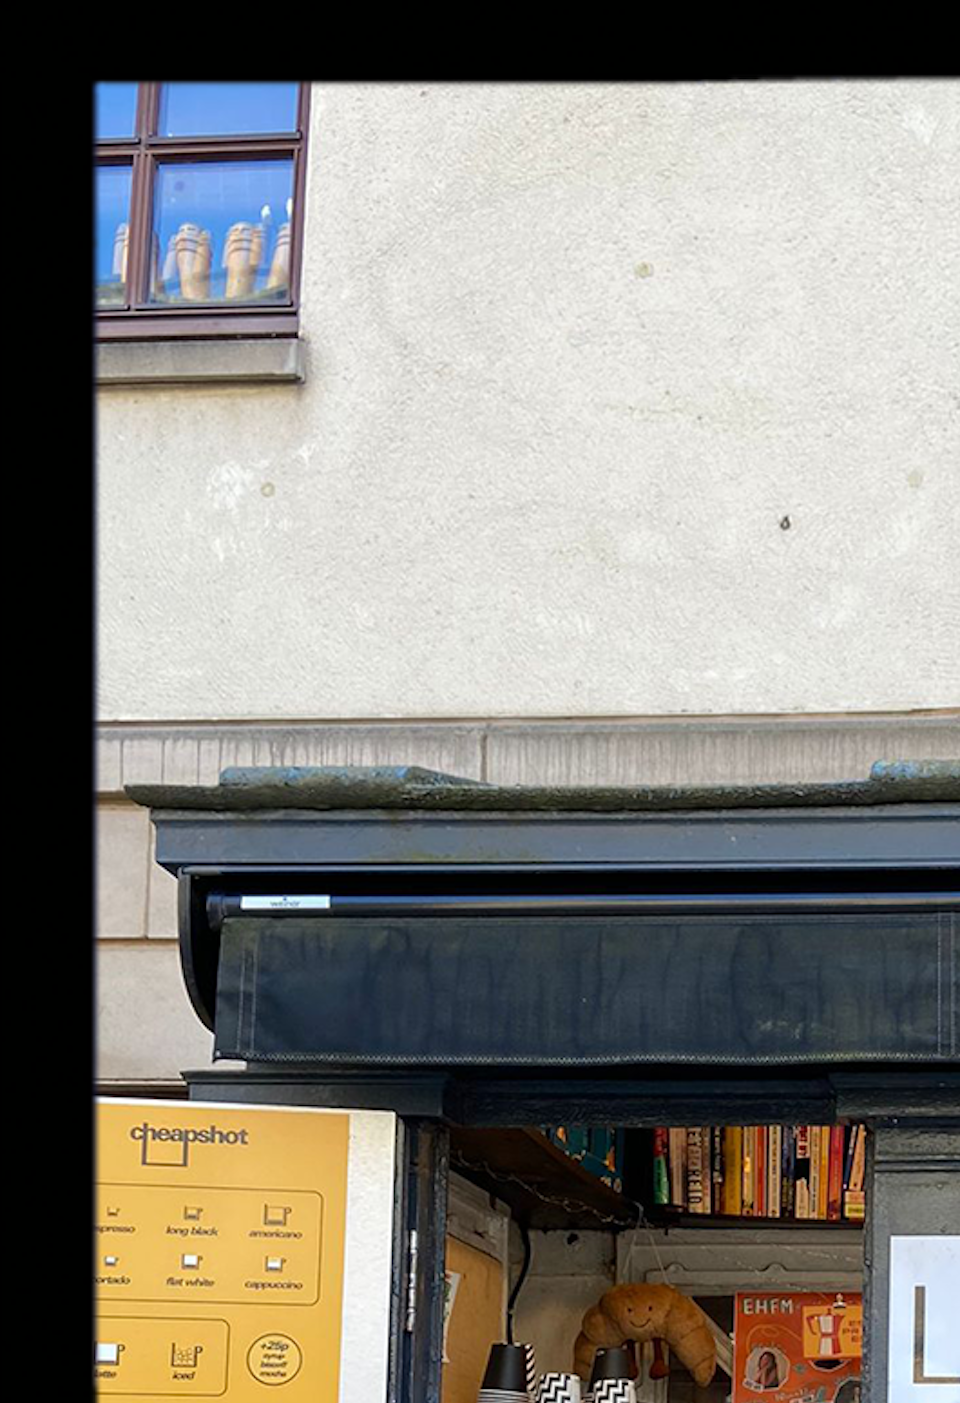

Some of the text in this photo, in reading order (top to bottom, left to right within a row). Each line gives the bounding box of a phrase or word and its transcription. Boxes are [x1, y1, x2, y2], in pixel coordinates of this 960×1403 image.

[130, 1122, 248, 1167] cheapshot
[95, 1225, 135, 1235] spresso
[166, 1226, 218, 1237] long black
[249, 1230, 303, 1239] americano
[95, 1276, 130, 1285] ortado
[167, 1277, 214, 1287] flat white
[245, 1281, 303, 1291] cappuccino
[743, 1297, 794, 1315] EHFM
[173, 1371, 195, 1380] iced
